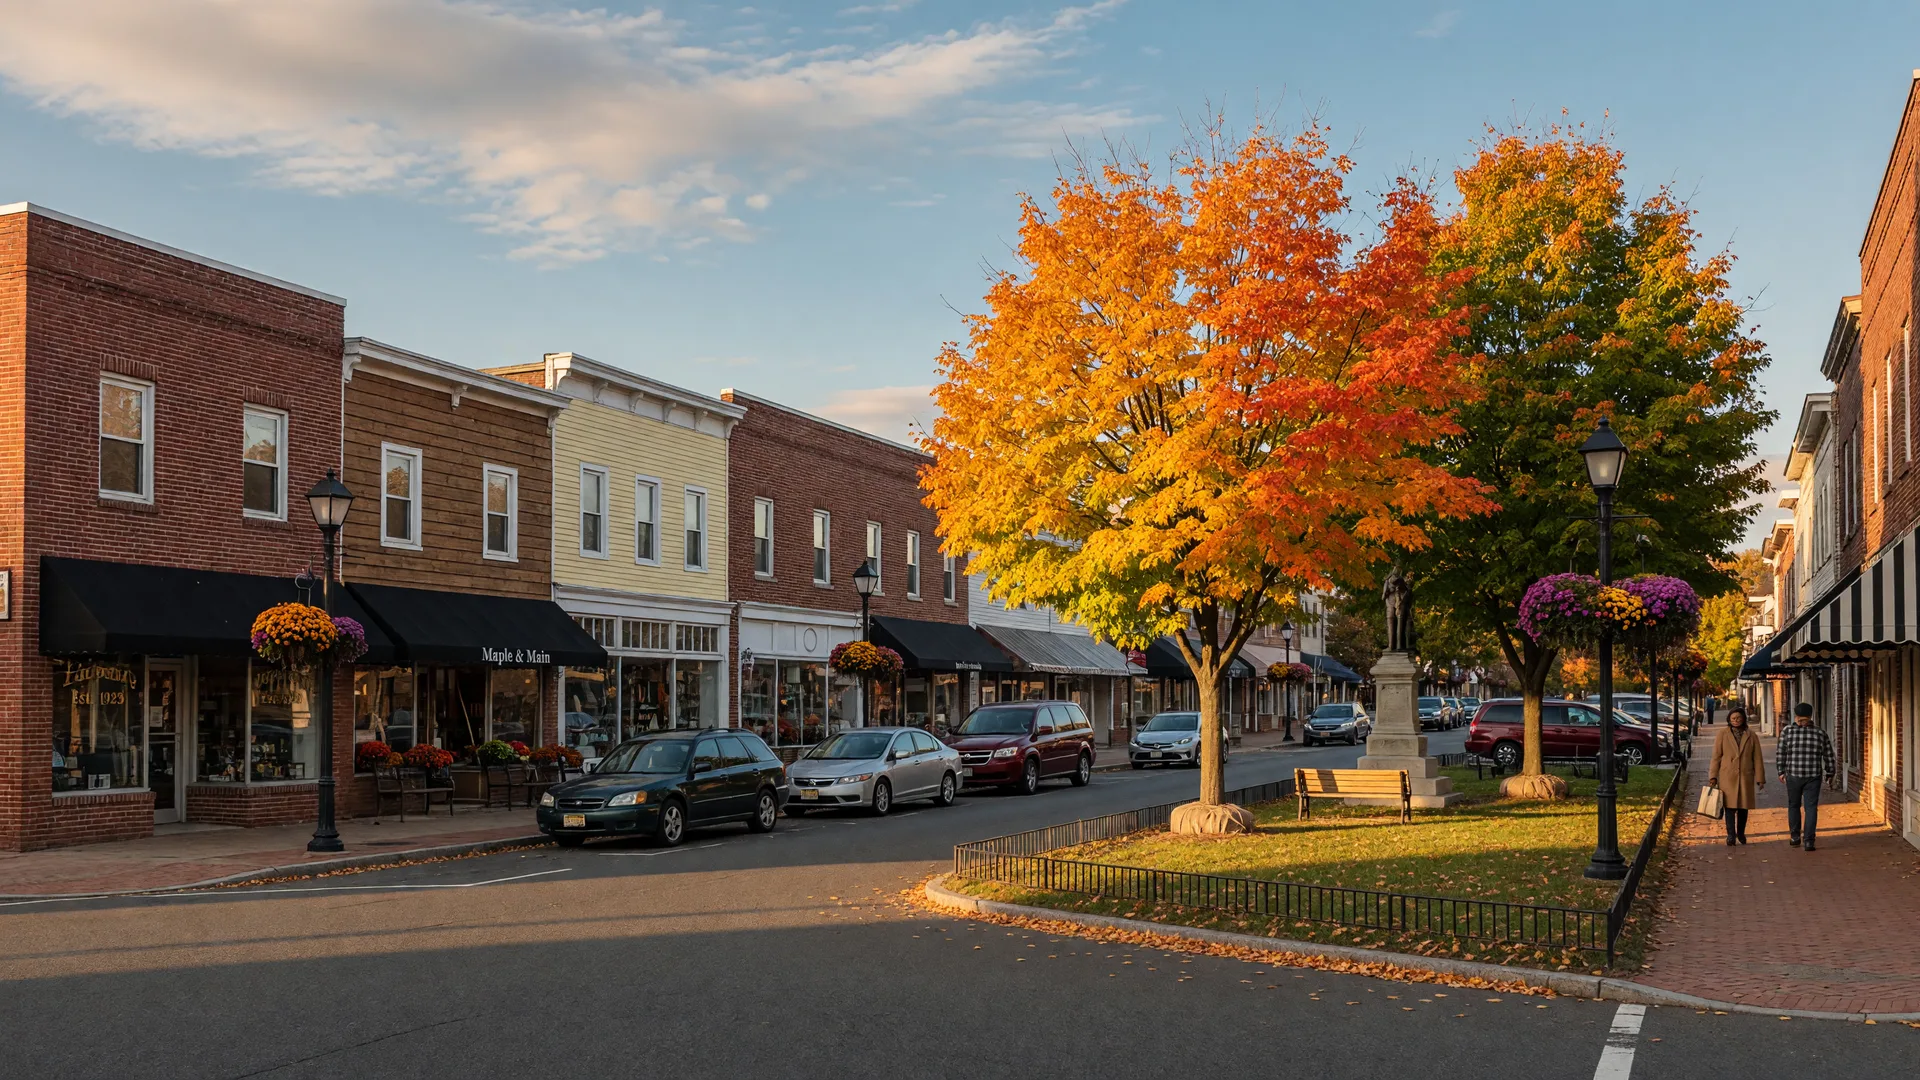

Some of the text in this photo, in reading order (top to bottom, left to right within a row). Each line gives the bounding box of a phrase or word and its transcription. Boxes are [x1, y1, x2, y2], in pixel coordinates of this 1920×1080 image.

[482, 647, 550, 665] Maple & Main
[100, 691, 125, 706] 1923
